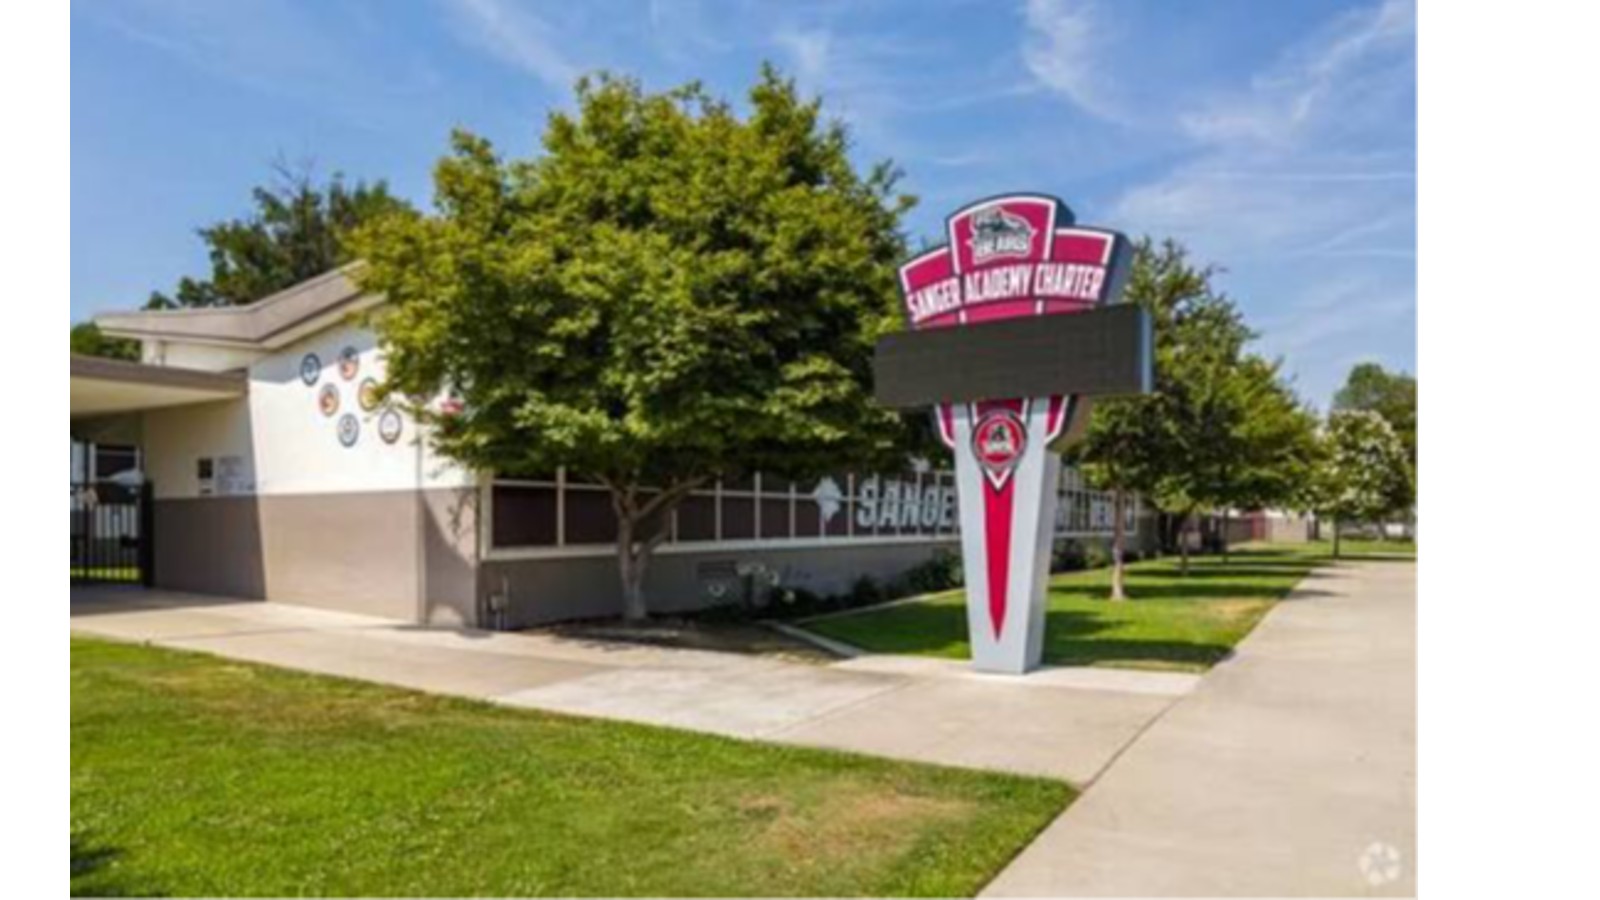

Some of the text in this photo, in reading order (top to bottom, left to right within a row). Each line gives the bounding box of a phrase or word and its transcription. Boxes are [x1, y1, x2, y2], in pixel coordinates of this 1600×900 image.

[907, 263, 1105, 322] SANGER ACADEMY CHARTER
[857, 478, 957, 527] SANGE
